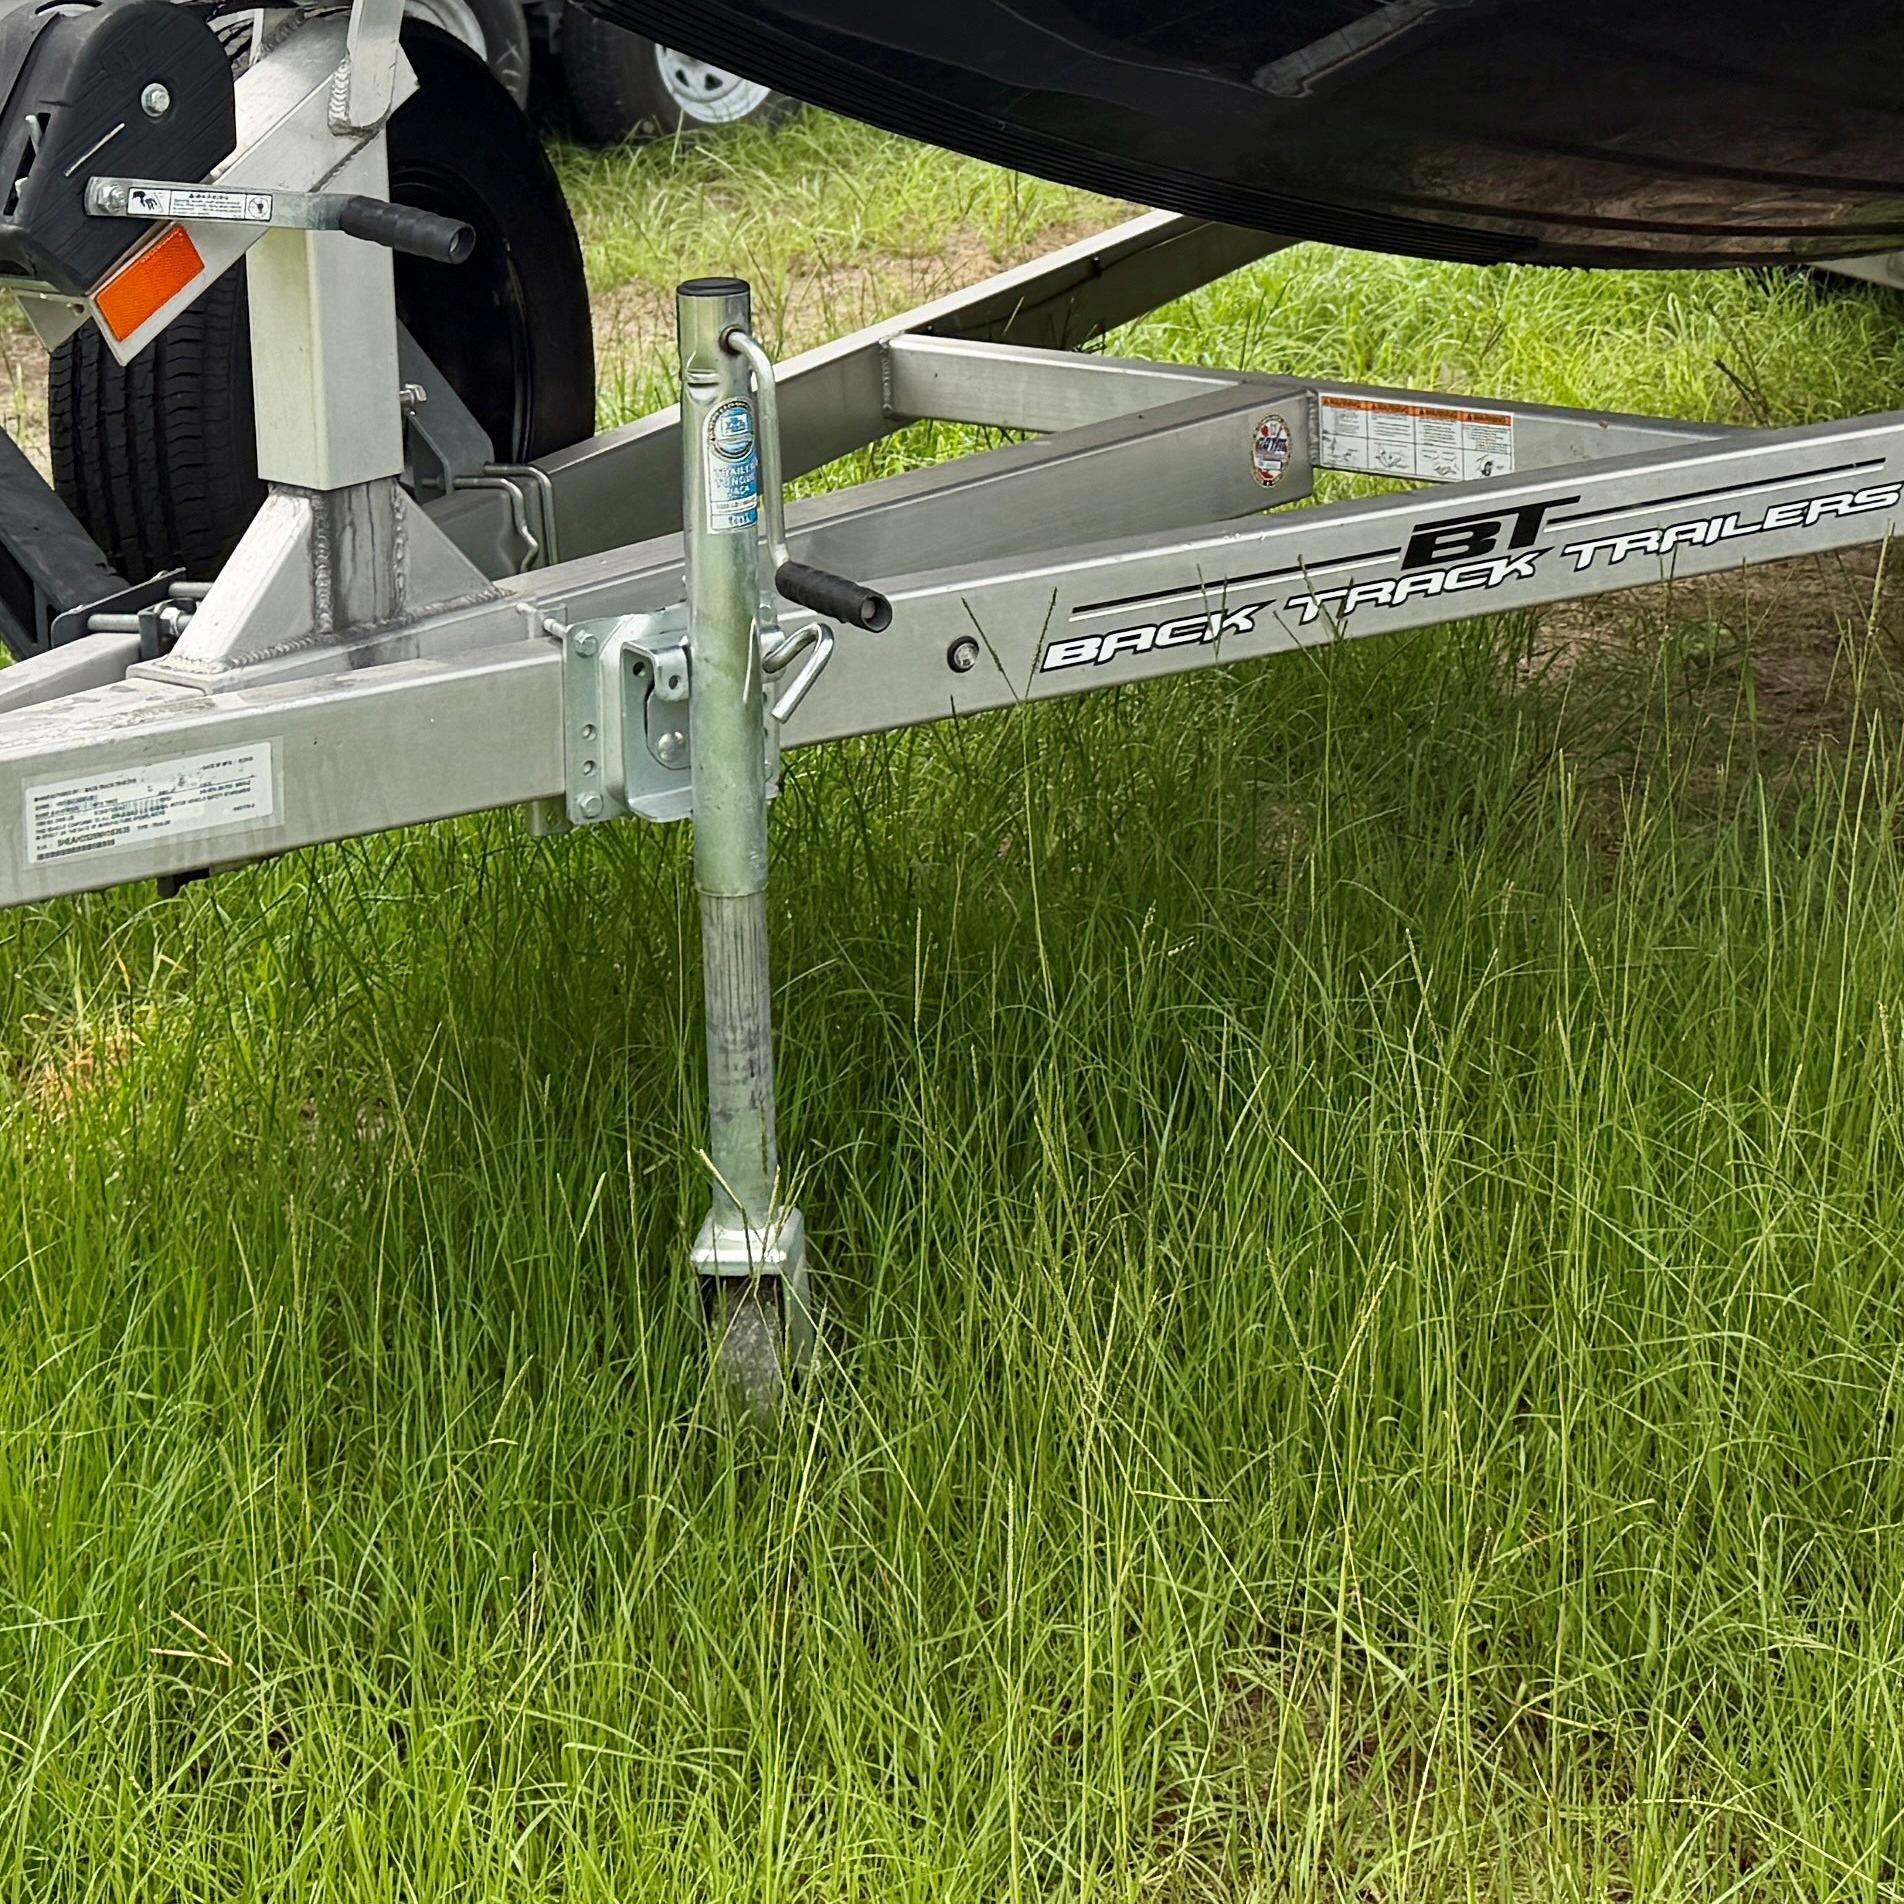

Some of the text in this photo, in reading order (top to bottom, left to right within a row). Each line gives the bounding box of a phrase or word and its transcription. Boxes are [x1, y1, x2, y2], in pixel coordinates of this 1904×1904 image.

[1401, 495, 1582, 570] BT
[1039, 599, 1277, 674] BACK
[1285, 547, 1555, 627] TRACK
